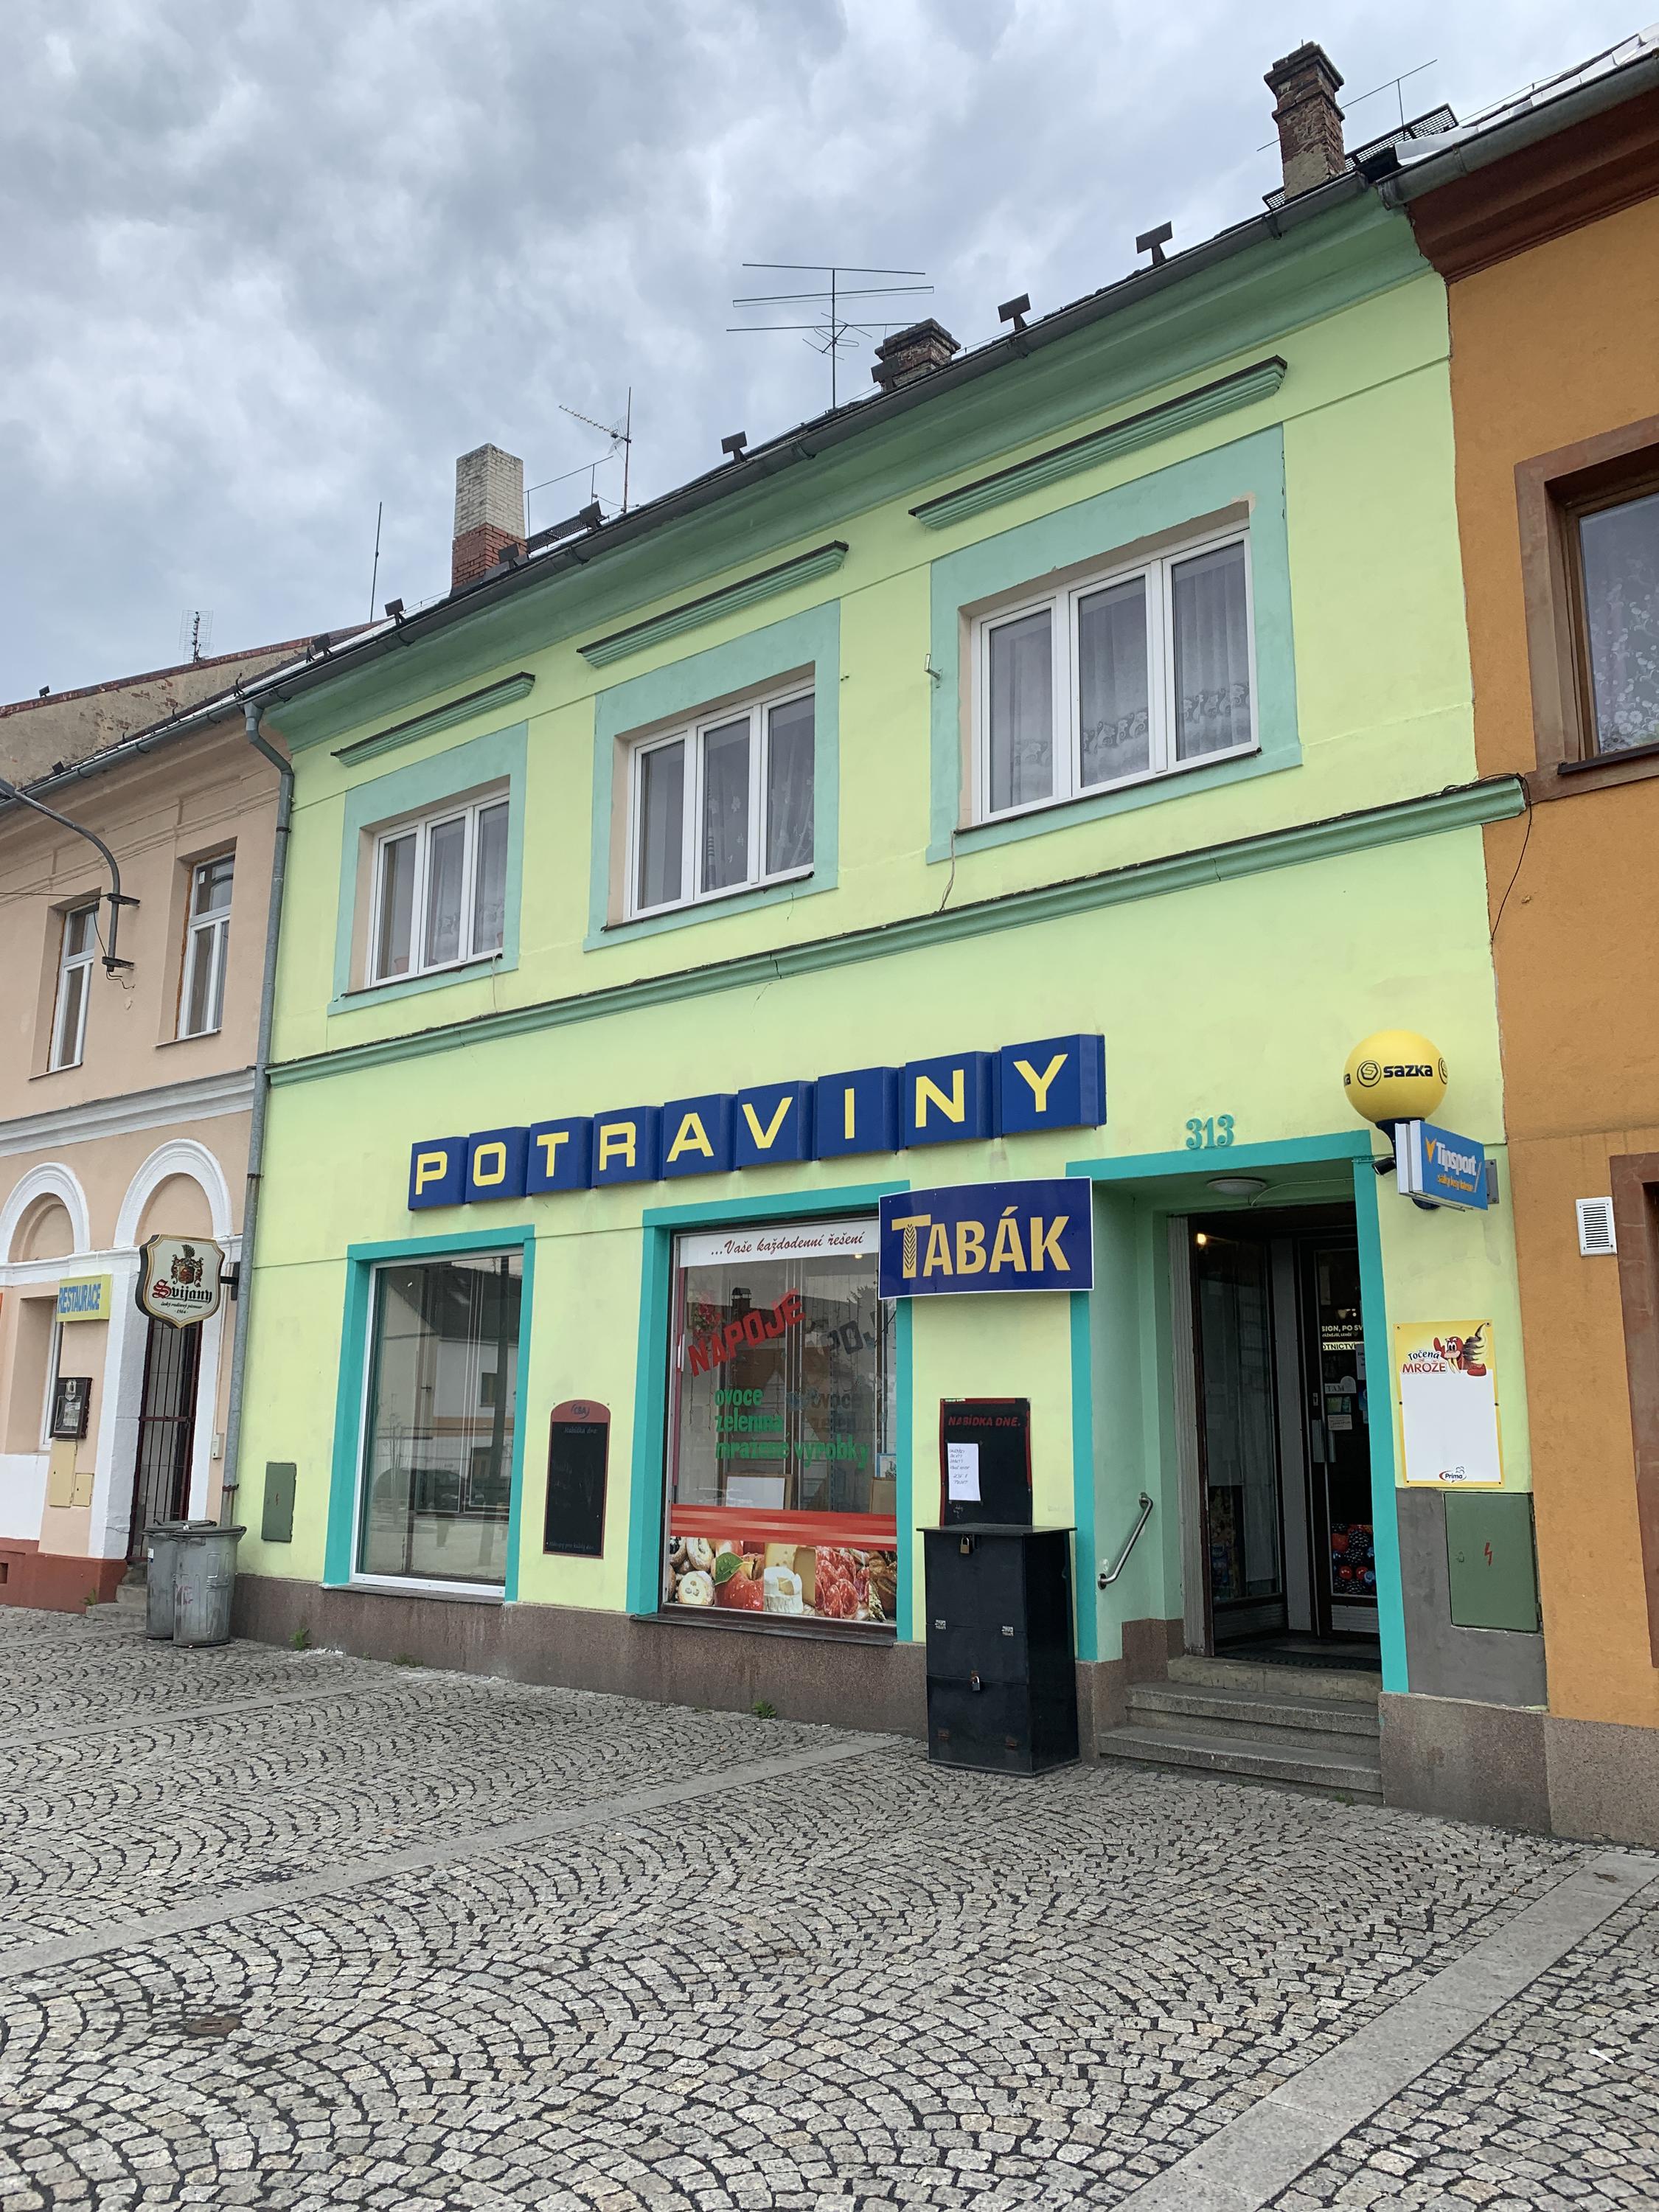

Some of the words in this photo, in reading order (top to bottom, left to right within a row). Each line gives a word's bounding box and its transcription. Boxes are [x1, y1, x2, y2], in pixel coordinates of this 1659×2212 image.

[416, 1054, 1068, 1194] POTRAVINY
[1186, 1114, 1234, 1150] 313
[1436, 1141, 1477, 1176] Tipsport
[757, 1234, 825, 1255] každodenní
[827, 1231, 866, 1246] řešení
[891, 1206, 1071, 1279] TABÁK
[58, 1284, 101, 1313] RESTAURACE
[152, 1279, 213, 1304] Svijany
[1402, 1360, 1446, 1373] MROŽE
[1408, 1349, 1441, 1360] Točená
[714, 1388, 764, 1407] ovoce
[714, 1407, 785, 1432] zelenina
